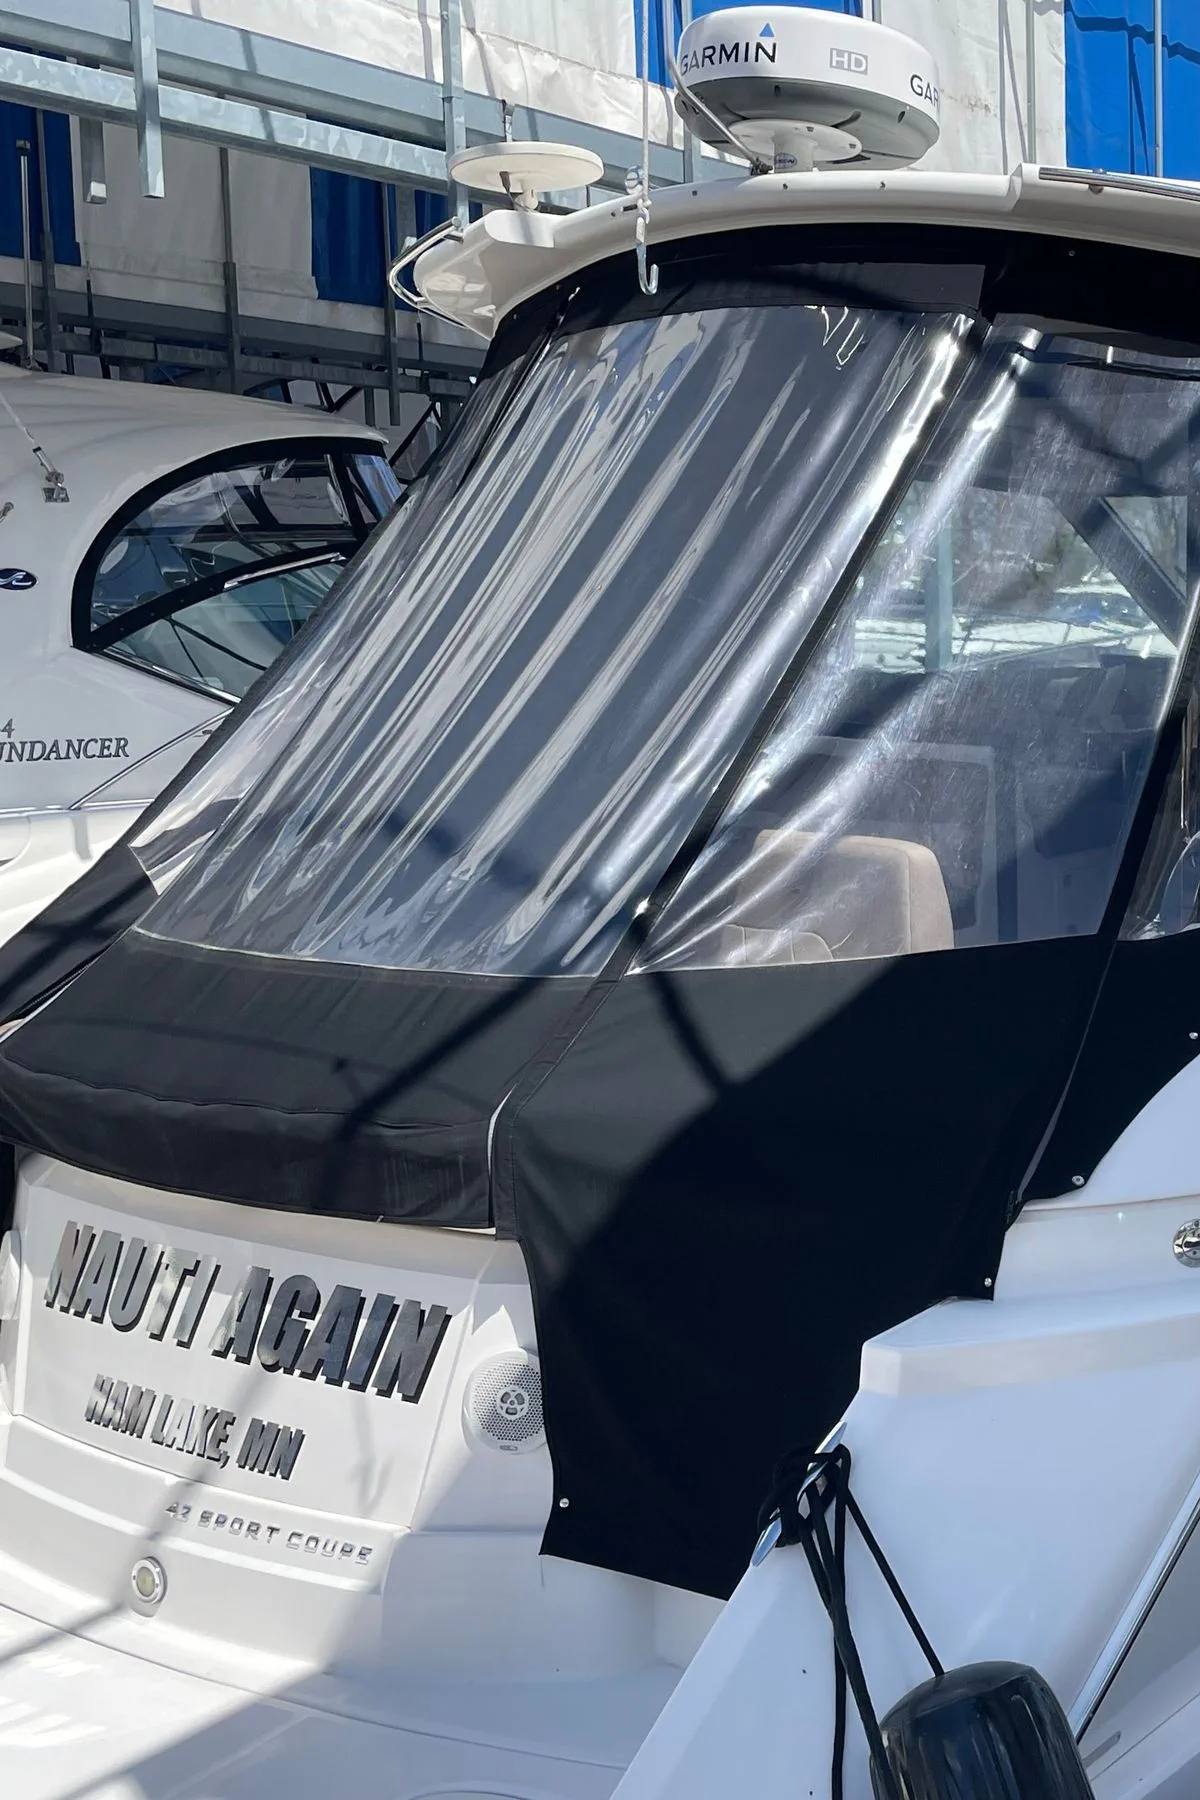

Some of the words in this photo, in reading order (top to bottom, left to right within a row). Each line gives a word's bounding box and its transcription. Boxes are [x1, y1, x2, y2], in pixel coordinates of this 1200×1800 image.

[681, 41, 777, 77] GARMIN
[831, 49, 867, 73] HD
[43, 1220, 221, 1349] NAUTI
[208, 1266, 453, 1405] AGAIN
[84, 1373, 157, 1440] HAM
[150, 1394, 237, 1469] LAKE,
[236, 1417, 306, 1481] MN
[164, 1501, 193, 1523] 42
[198, 1509, 281, 1544] SPORT
[286, 1531, 374, 1566] COUPE
